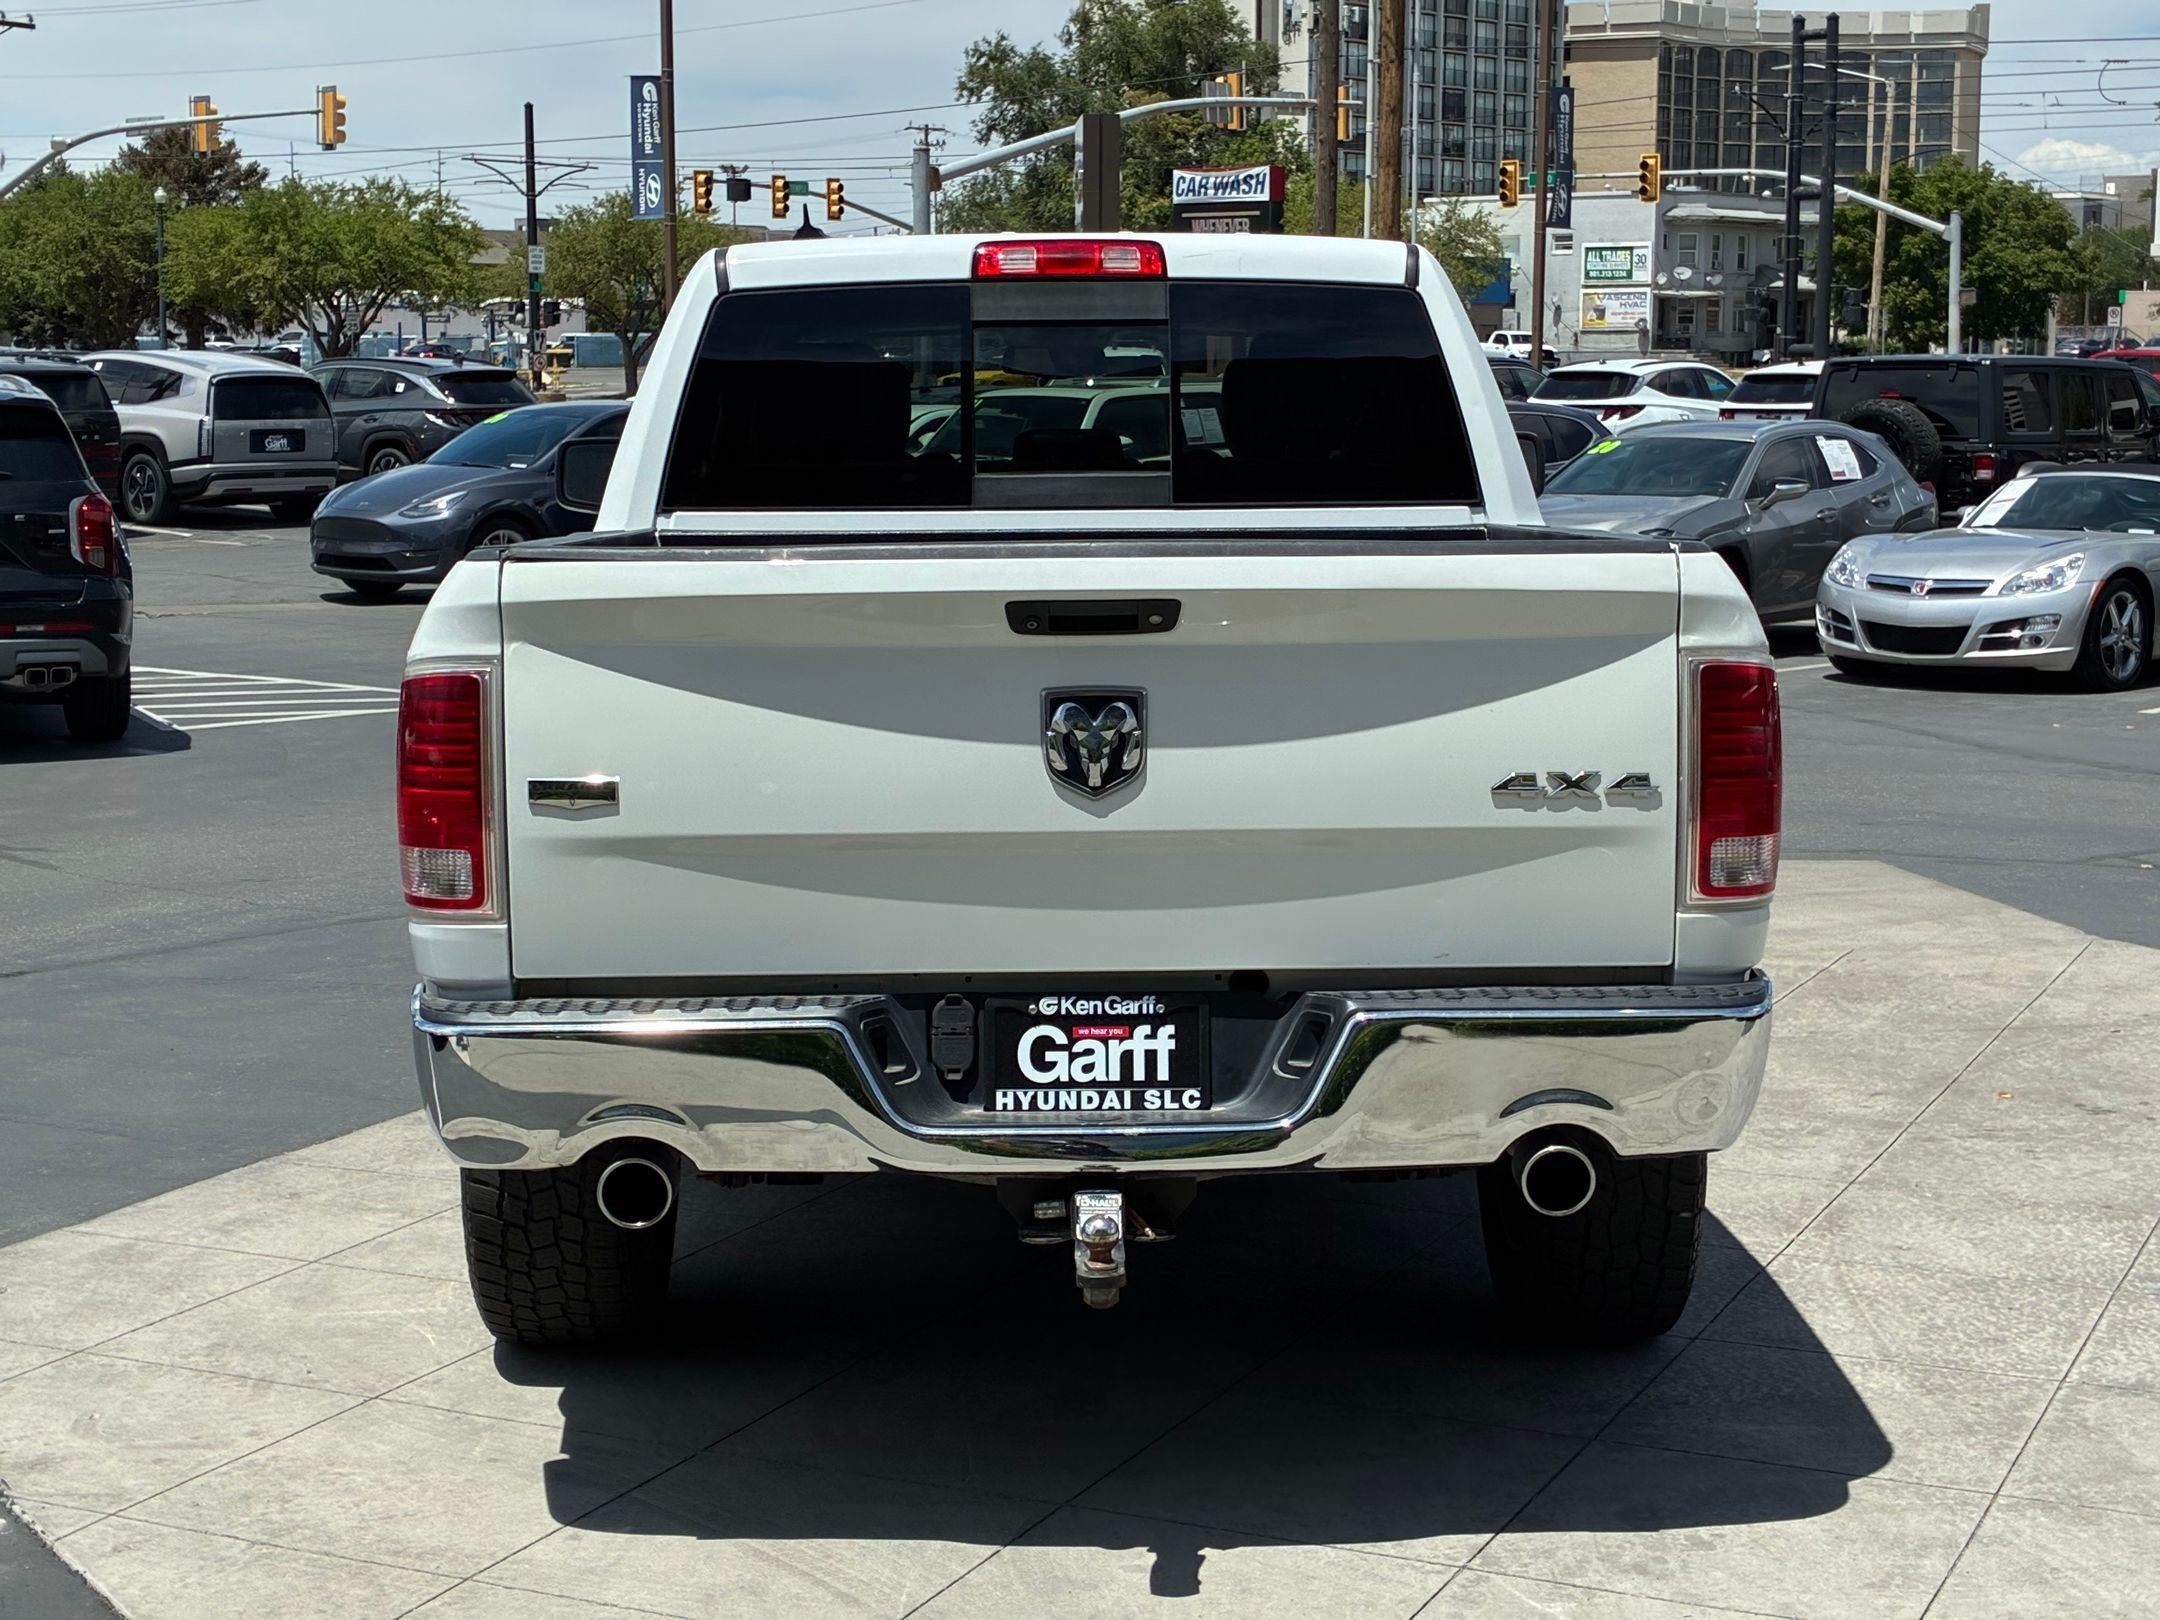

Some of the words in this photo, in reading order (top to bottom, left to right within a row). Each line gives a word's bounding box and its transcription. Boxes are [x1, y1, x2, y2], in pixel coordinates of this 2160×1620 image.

[642, 103, 654, 154] Hyundai
[652, 121, 661, 143] Garff
[1175, 175, 1210, 198] CAR
[1213, 172, 1267, 196] WASH
[1192, 218, 1250, 233] WHENEVER
[1587, 250, 1601, 261] ALL
[1602, 250, 1631, 262] TRADES
[1634, 253, 1647, 265] 30
[1606, 293, 1647, 301] ASCEND
[1060, 996, 1101, 1015] Ken
[1104, 995, 1157, 1015] Garff
[1090, 1027, 1107, 1035] hear
[1108, 1028, 1123, 1037] you
[1017, 1024, 1176, 1084] Garff
[995, 1089, 1131, 1111] HYUNDAI
[1143, 1089, 1201, 1110] SLC
